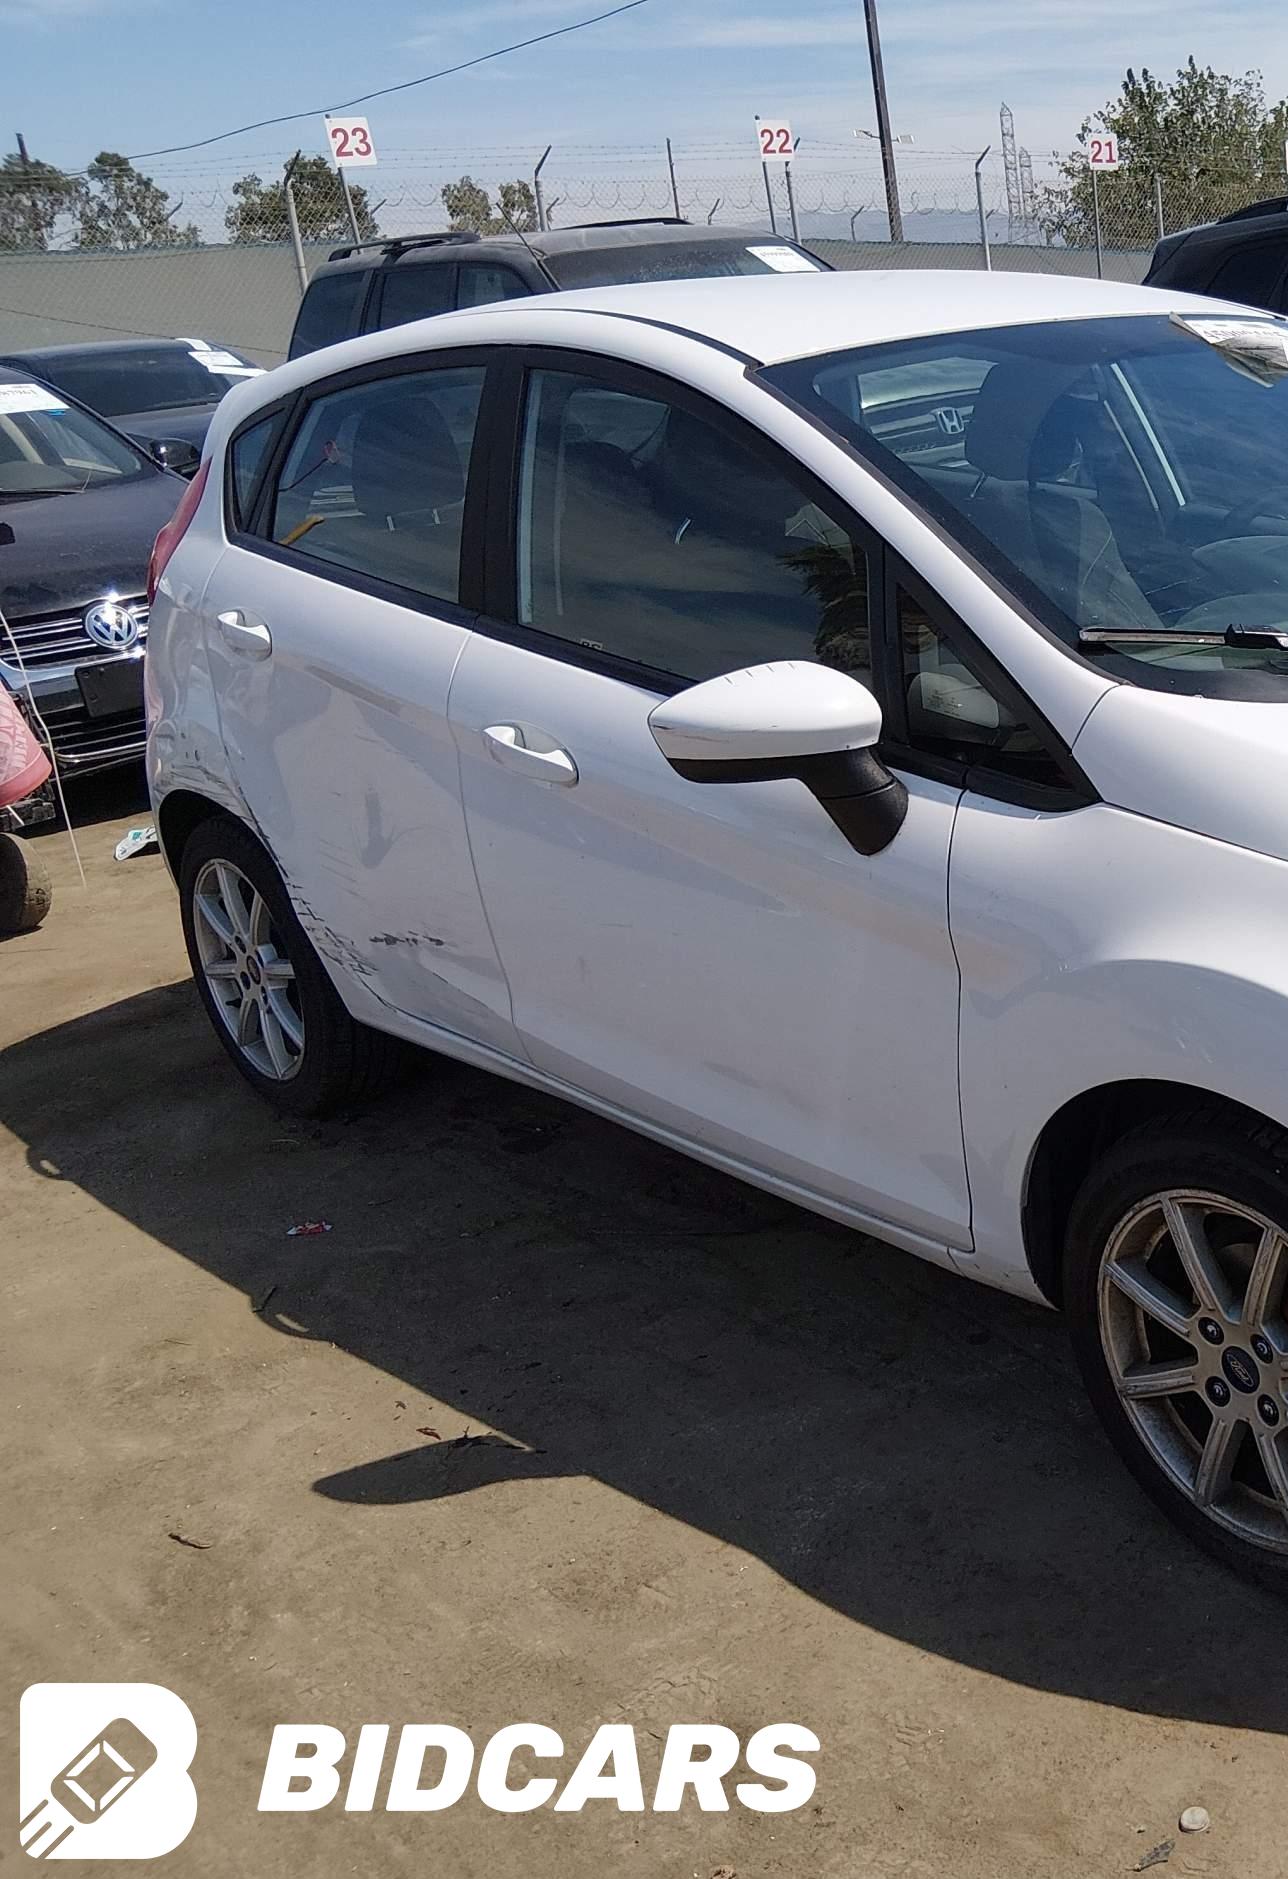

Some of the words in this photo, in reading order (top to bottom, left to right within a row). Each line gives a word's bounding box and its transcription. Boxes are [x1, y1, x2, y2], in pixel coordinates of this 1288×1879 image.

[331, 127, 372, 157] 23
[760, 128, 792, 154] 22
[1090, 140, 1117, 163] 21
